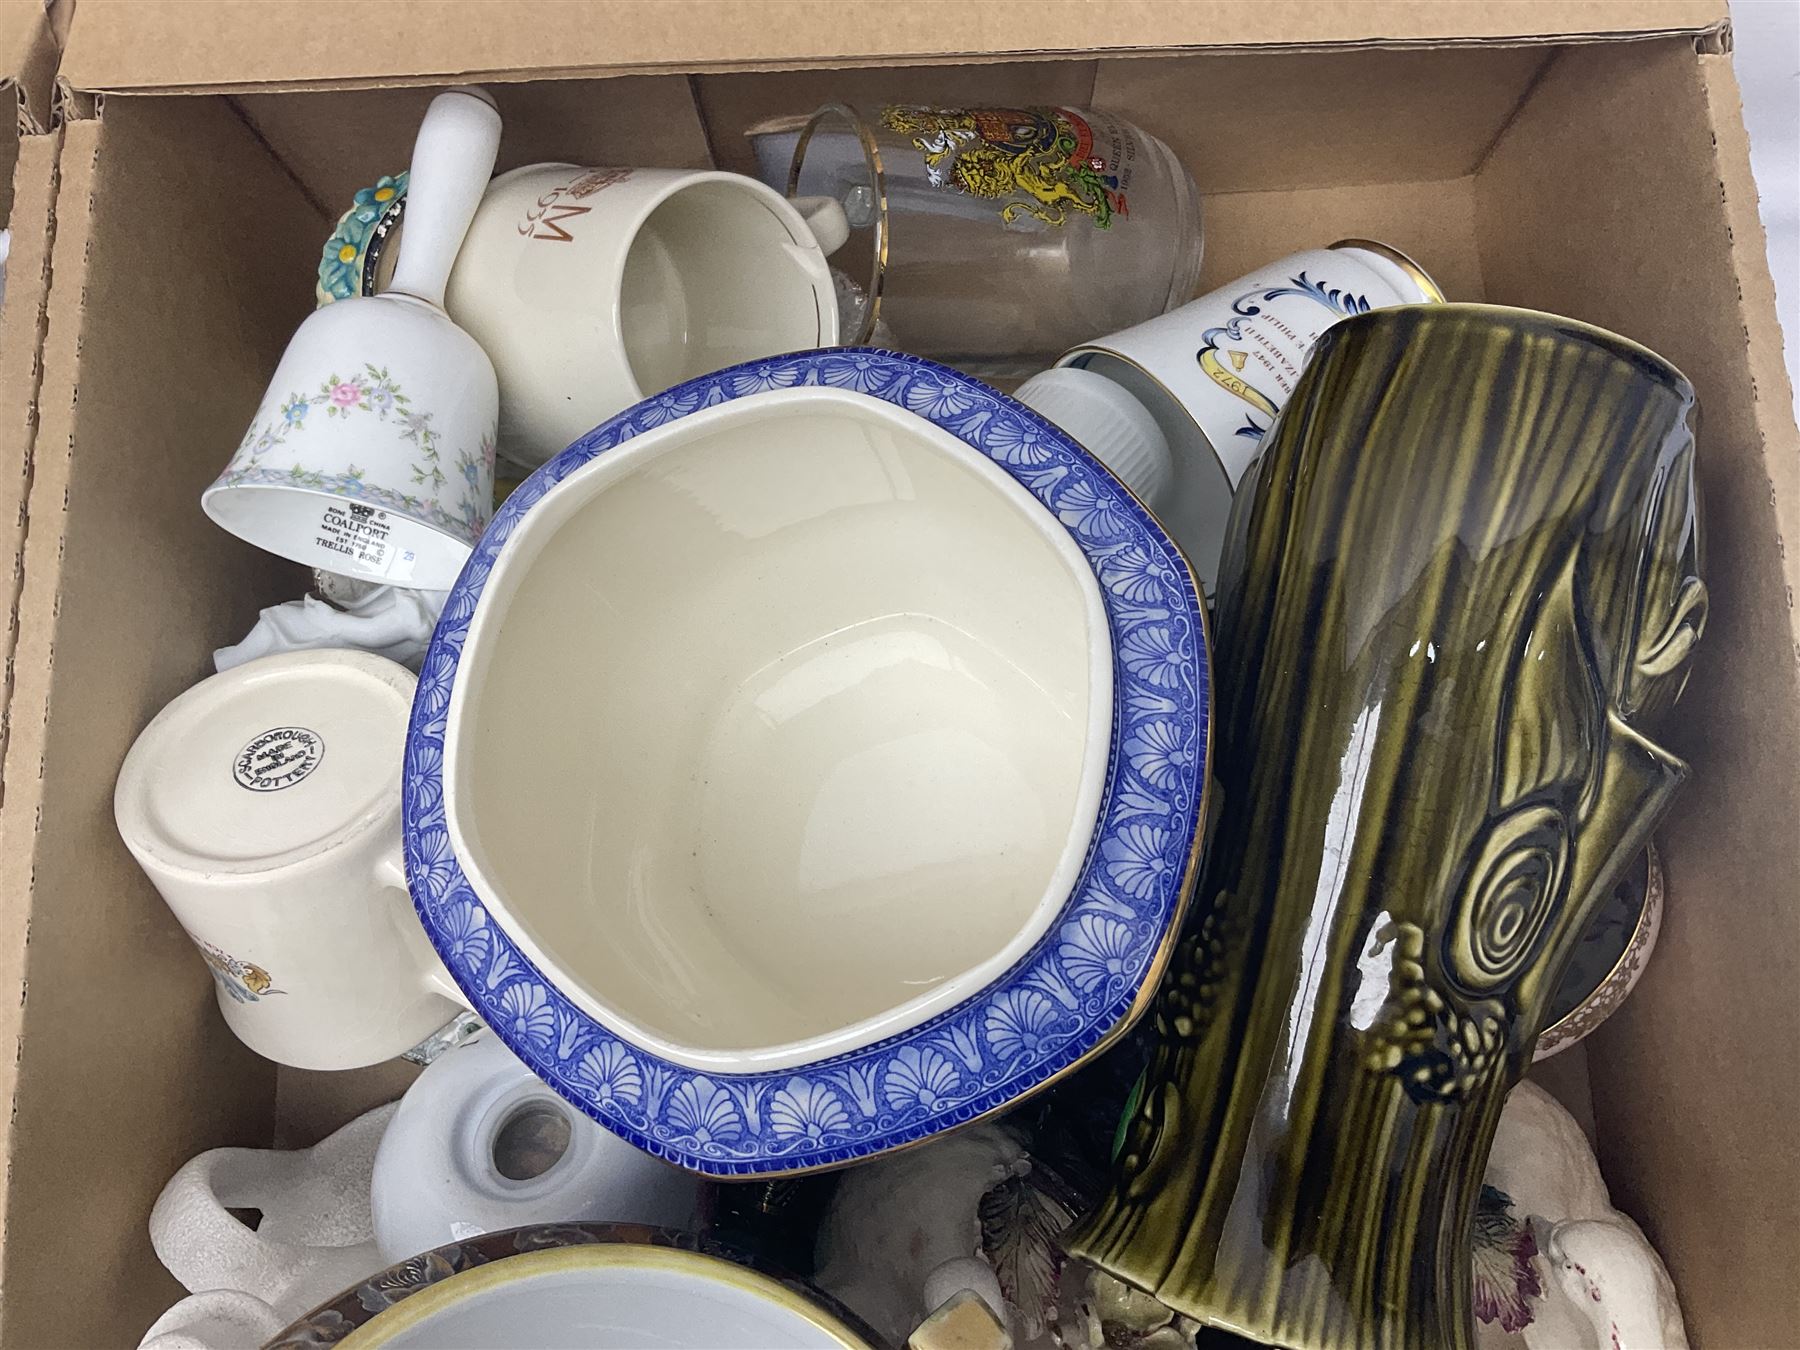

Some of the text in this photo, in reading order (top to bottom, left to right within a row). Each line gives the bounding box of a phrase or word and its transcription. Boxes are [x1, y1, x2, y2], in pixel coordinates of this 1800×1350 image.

[1109, 137, 1122, 171] QUEEN
[518, 187, 568, 237] 1935
[533, 205, 592, 242] M
[1261, 314, 1297, 341] PHILIP
[1252, 351, 1276, 372] 1947
[1212, 369, 1250, 396] 1972
[323, 513, 389, 540] COALPORT
[328, 507, 391, 531] BONE CHINA
[321, 524, 340, 535] MADE
[353, 535, 385, 549] ENGLAND
[336, 537, 349, 545] EST
[316, 537, 383, 565] TRELLIS ROSE
[256, 741, 293, 761] MADE
[250, 756, 316, 788] POTTERY
